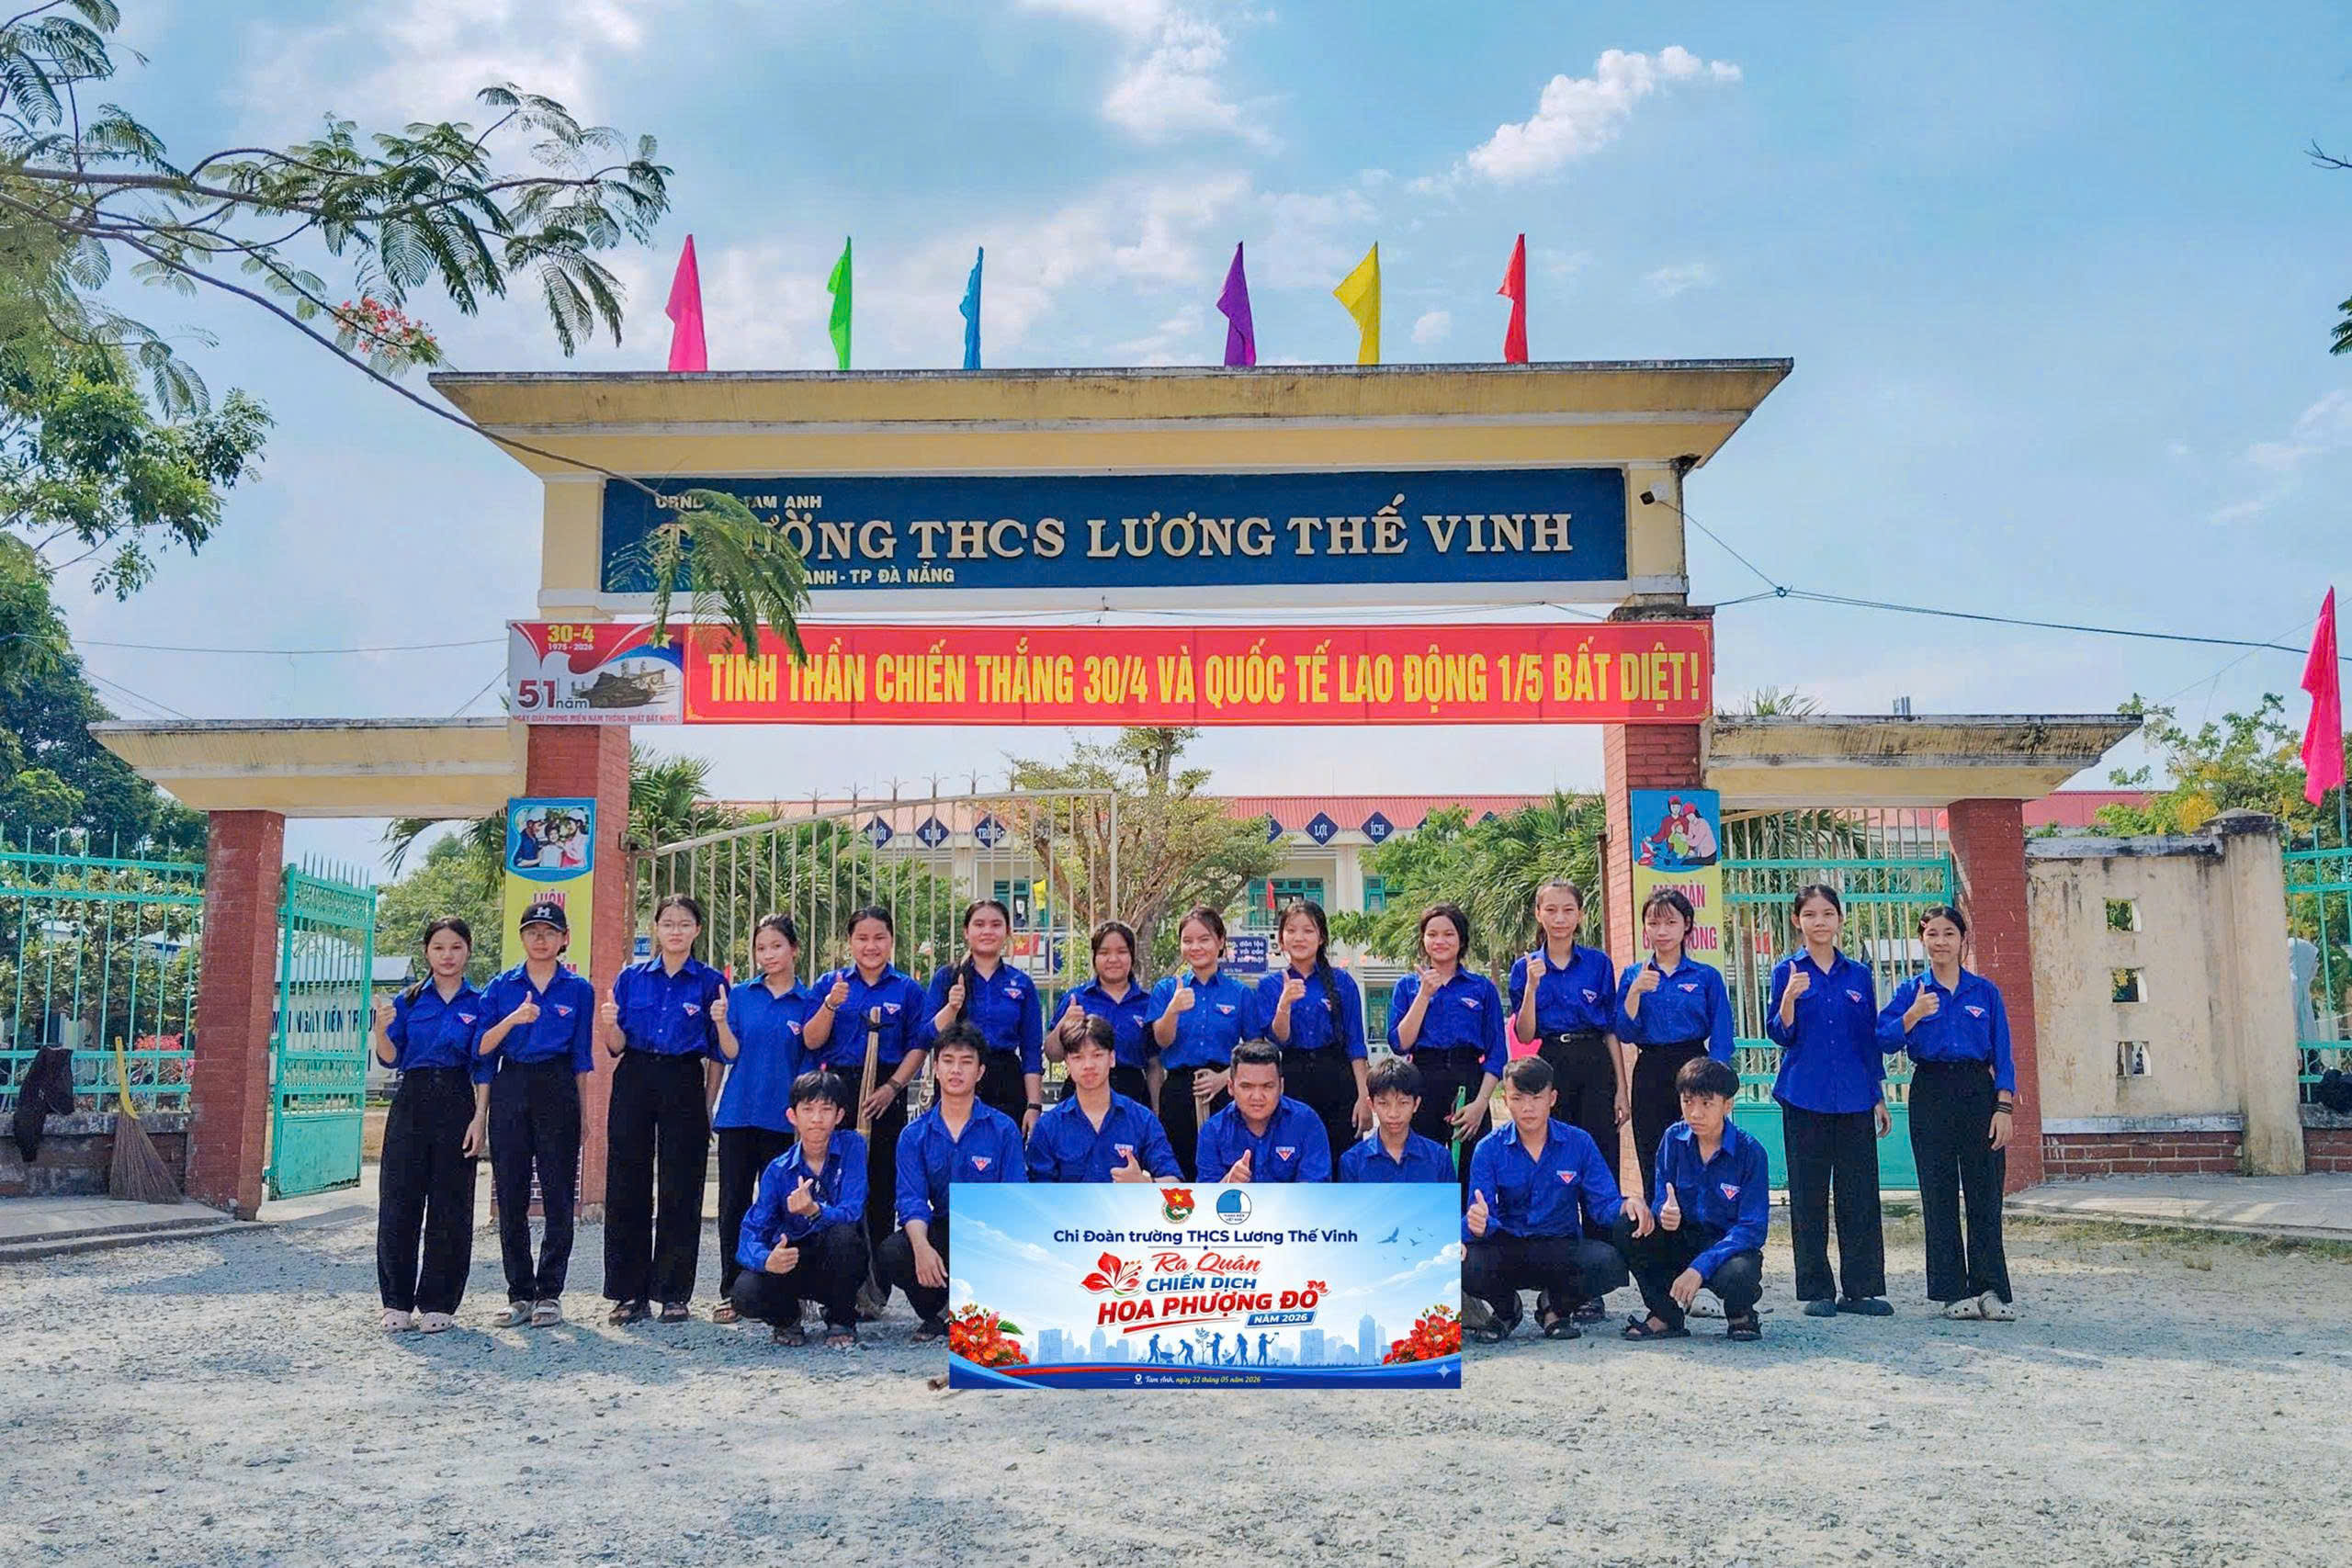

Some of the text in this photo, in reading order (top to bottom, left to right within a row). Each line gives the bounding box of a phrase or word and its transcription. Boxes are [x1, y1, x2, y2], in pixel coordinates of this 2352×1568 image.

[785, 496, 822, 508] ANH
[654, 493, 1574, 560] TỜNG THCS LƯƠNG THẾ VINH
[850, 570, 872, 584] TP
[877, 565, 901, 584] ĐÀ
[907, 561, 955, 584] NẴNG
[548, 625, 595, 643] 30-4
[787, 637, 865, 703] THẦN
[876, 638, 967, 704] CHIẾN
[976, 637, 1074, 705] THẮNG
[1083, 653, 1148, 705] 30/4
[1157, 645, 1197, 704] VÀ
[1204, 638, 1285, 709] QUỐC
[1295, 638, 1331, 703] TẾ
[1339, 653, 1394, 703] LAO
[1402, 644, 1488, 714] ĐỘNG
[1498, 653, 1544, 703] 1/5
[1554, 637, 1610, 702] BẤT
[517, 680, 588, 709] 51 năm
